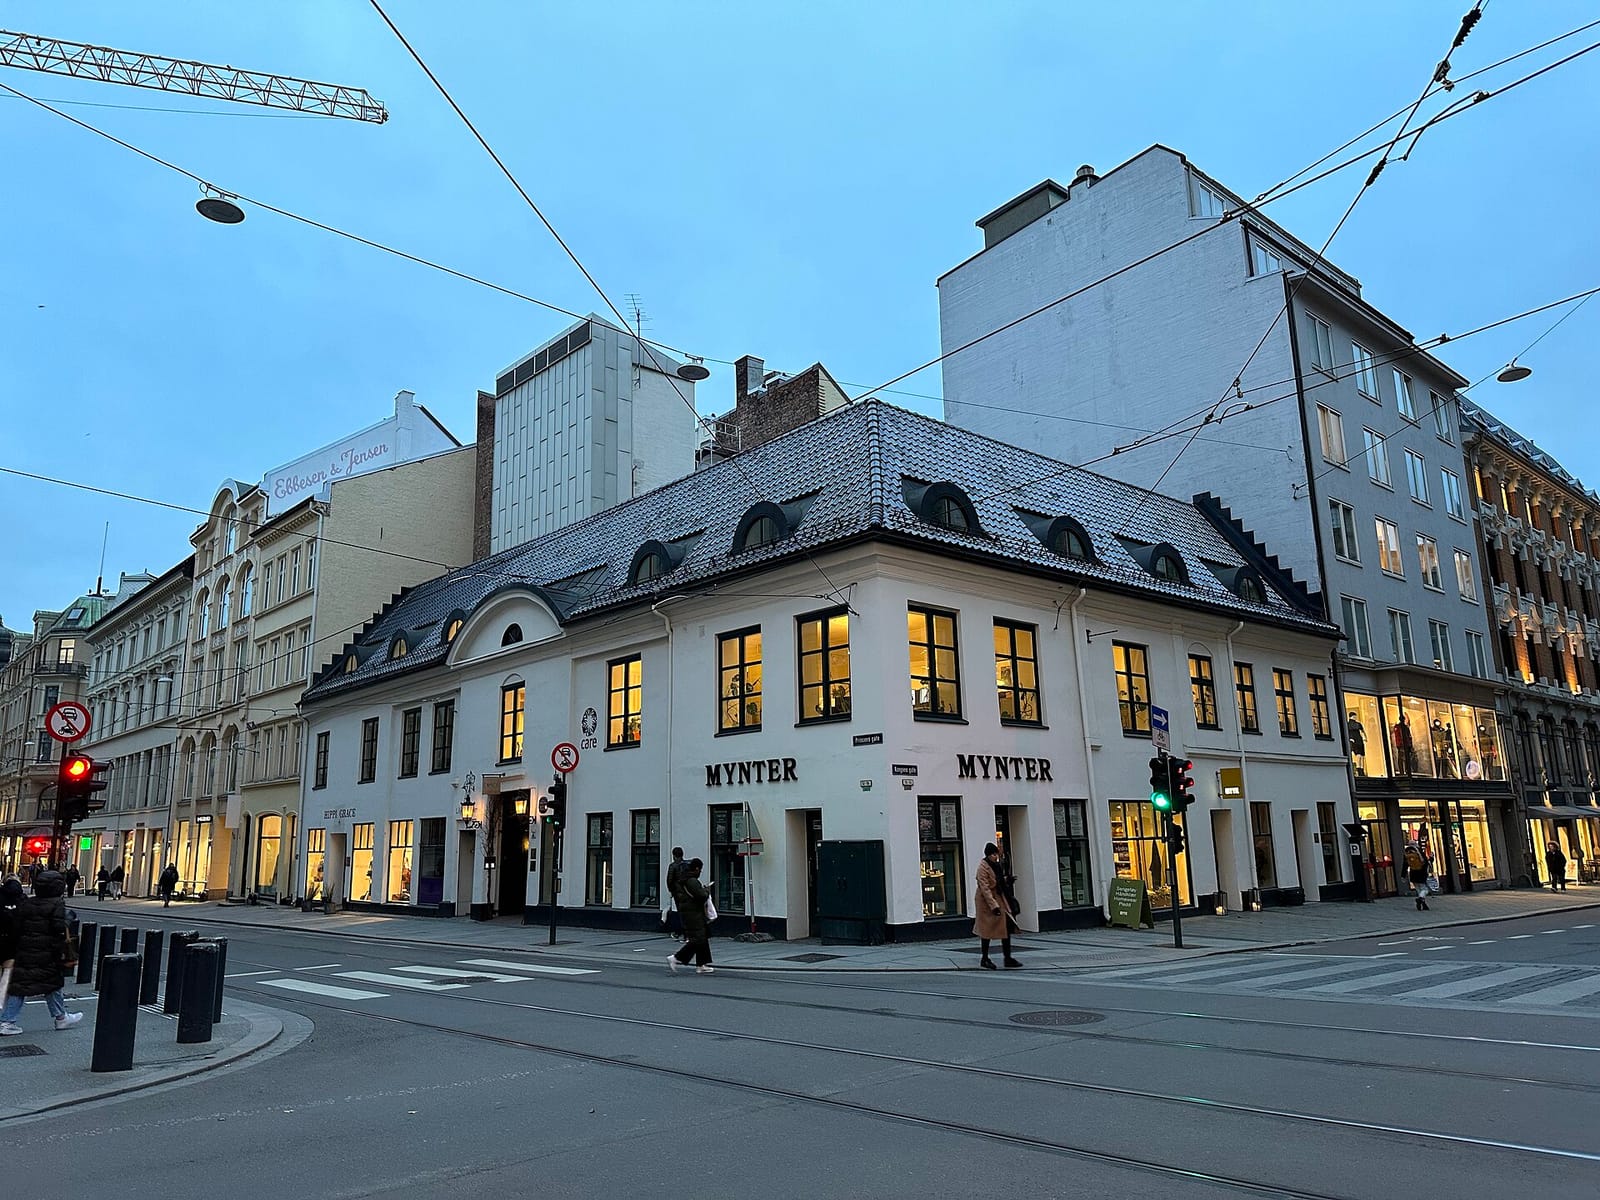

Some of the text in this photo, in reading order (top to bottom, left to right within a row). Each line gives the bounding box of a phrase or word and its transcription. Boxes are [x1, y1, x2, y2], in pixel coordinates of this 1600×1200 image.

[274, 443, 388, 499] Ebbesen & Jensen
[581, 738, 597, 749] care
[705, 758, 798, 786] MYNTER
[956, 754, 1053, 781] MYNTER
[1351, 845, 1358, 854] P
